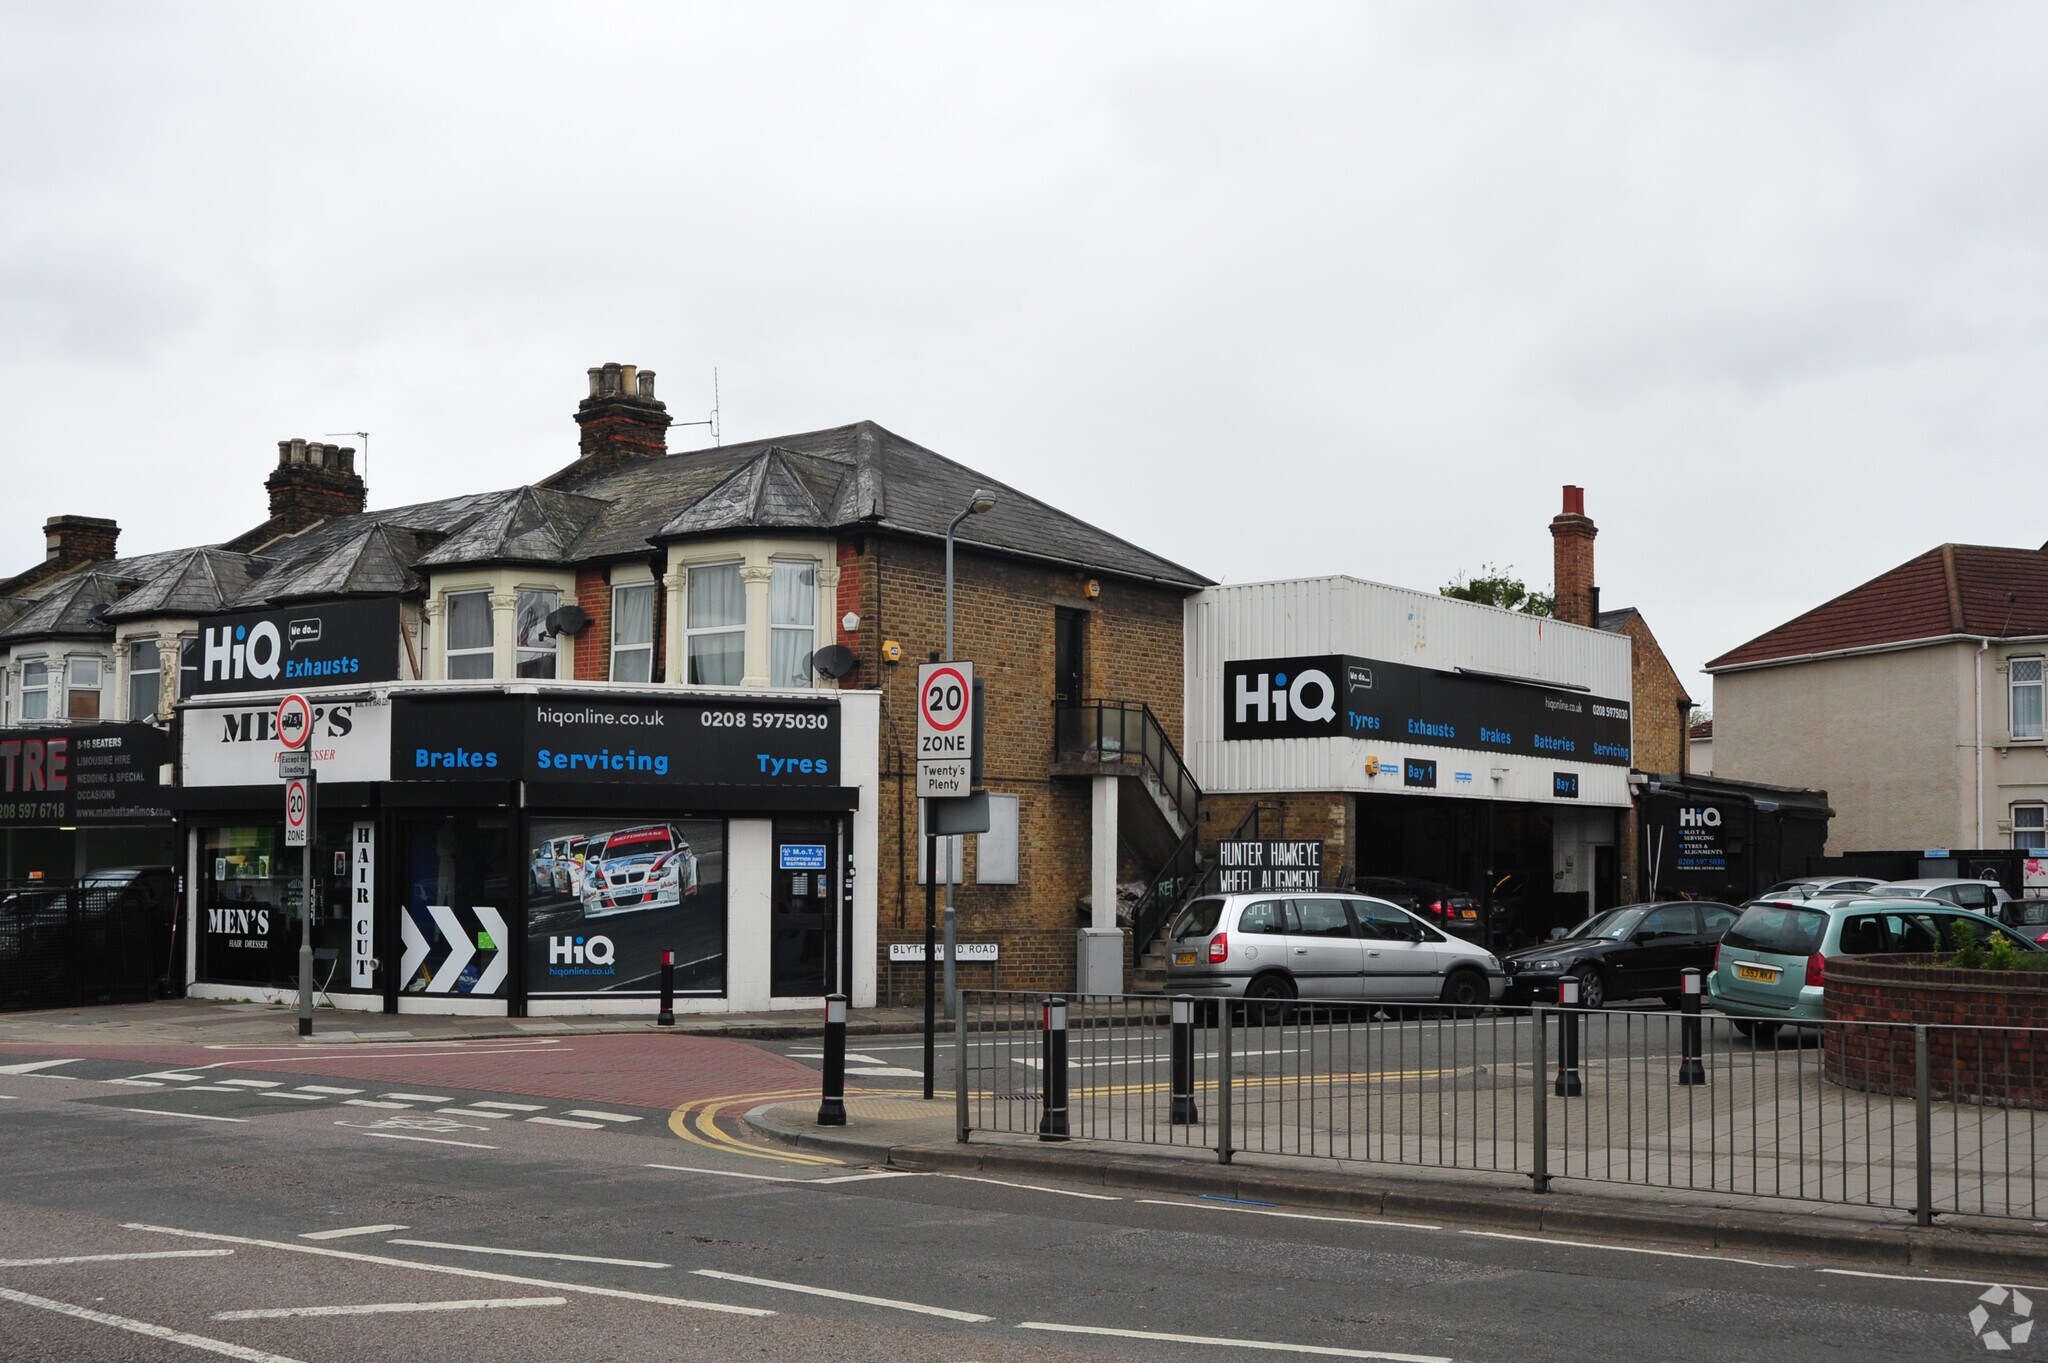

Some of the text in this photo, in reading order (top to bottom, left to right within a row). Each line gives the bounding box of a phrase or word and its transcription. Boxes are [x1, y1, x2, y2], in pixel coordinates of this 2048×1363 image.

[291, 626, 300, 635] We
[204, 620, 281, 681] HiQ
[285, 656, 359, 678] Exhausts
[1350, 672, 1357, 680] We
[929, 685, 962, 711] 20
[1235, 669, 1336, 723] HiQ
[1545, 697, 1628, 720] hiqonline.co.uk 0208 5975030
[221, 706, 353, 743] ME'S
[537, 706, 828, 729] hiqonline.co.uk 0208 5975030
[92, 737, 122, 748] SEATERS
[922, 735, 965, 751] ZONE
[1348, 711, 1629, 761] Tyres Exhausts Brakes Batteries Servicing
[77, 755, 131, 766] LIMOUSINE HIRE
[282, 756, 299, 765] Except
[416, 747, 828, 776] Brakes Servicing Tyres
[77, 772, 145, 783] WEDDING & SPECIAL
[284, 766, 304, 775] loading
[923, 765, 965, 779] Twenty's
[1408, 765, 1424, 780] Bay
[1428, 766, 1433, 779] 1
[928, 779, 959, 791] Plenty
[1556, 778, 1576, 791] Bay 2
[77, 790, 115, 800] OCCASIONS
[18, 803, 37, 819] 597
[39, 802, 65, 818] 6718
[290, 795, 303, 813] 20
[1680, 807, 1722, 826] HiQ
[287, 829, 304, 841] ZONE
[1220, 842, 1320, 866] HUNTER HAWKEYE
[357, 828, 370, 903] HAIR
[208, 908, 269, 935] MEN'S
[228, 939, 268, 949] HAIR DRESSER
[356, 919, 369, 975] CUT
[549, 935, 615, 965] HiQ
[893, 945, 996, 954] BLYTHWD ROAD
[549, 967, 615, 977] hiqonline.co.uk
